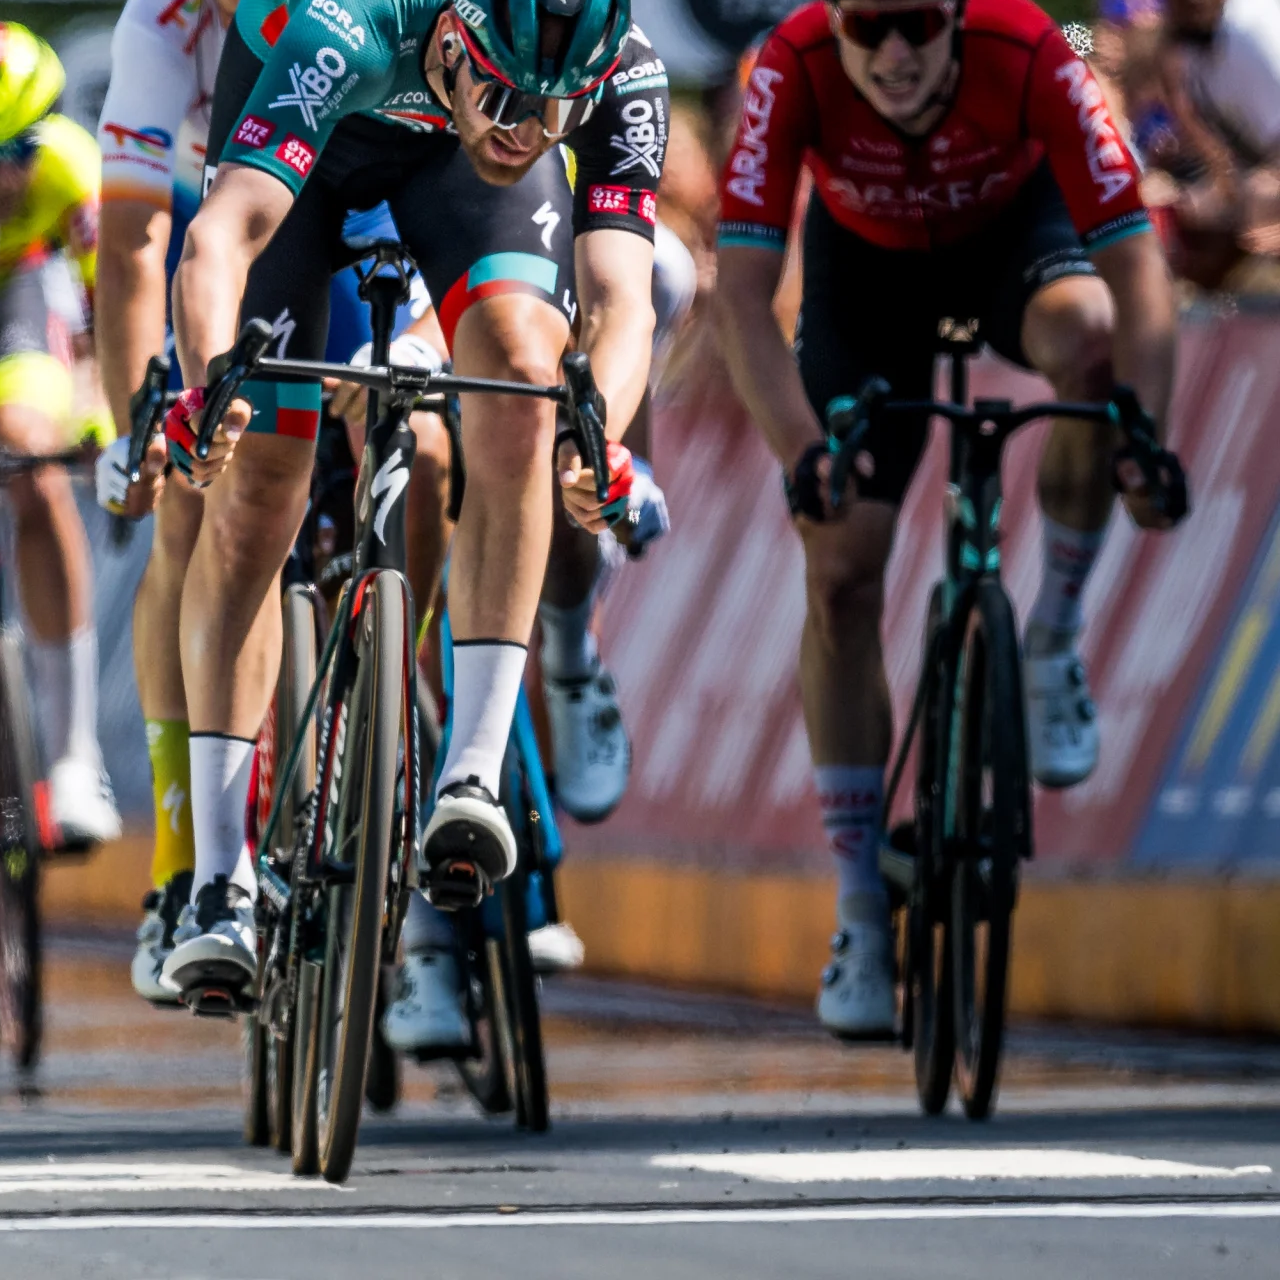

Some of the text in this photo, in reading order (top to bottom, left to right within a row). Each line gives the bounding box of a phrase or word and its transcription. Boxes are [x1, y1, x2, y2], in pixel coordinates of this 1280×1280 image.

[268, 47, 346, 132] XBO
[612, 58, 667, 86] BORA
[608, 99, 661, 178] XBO
